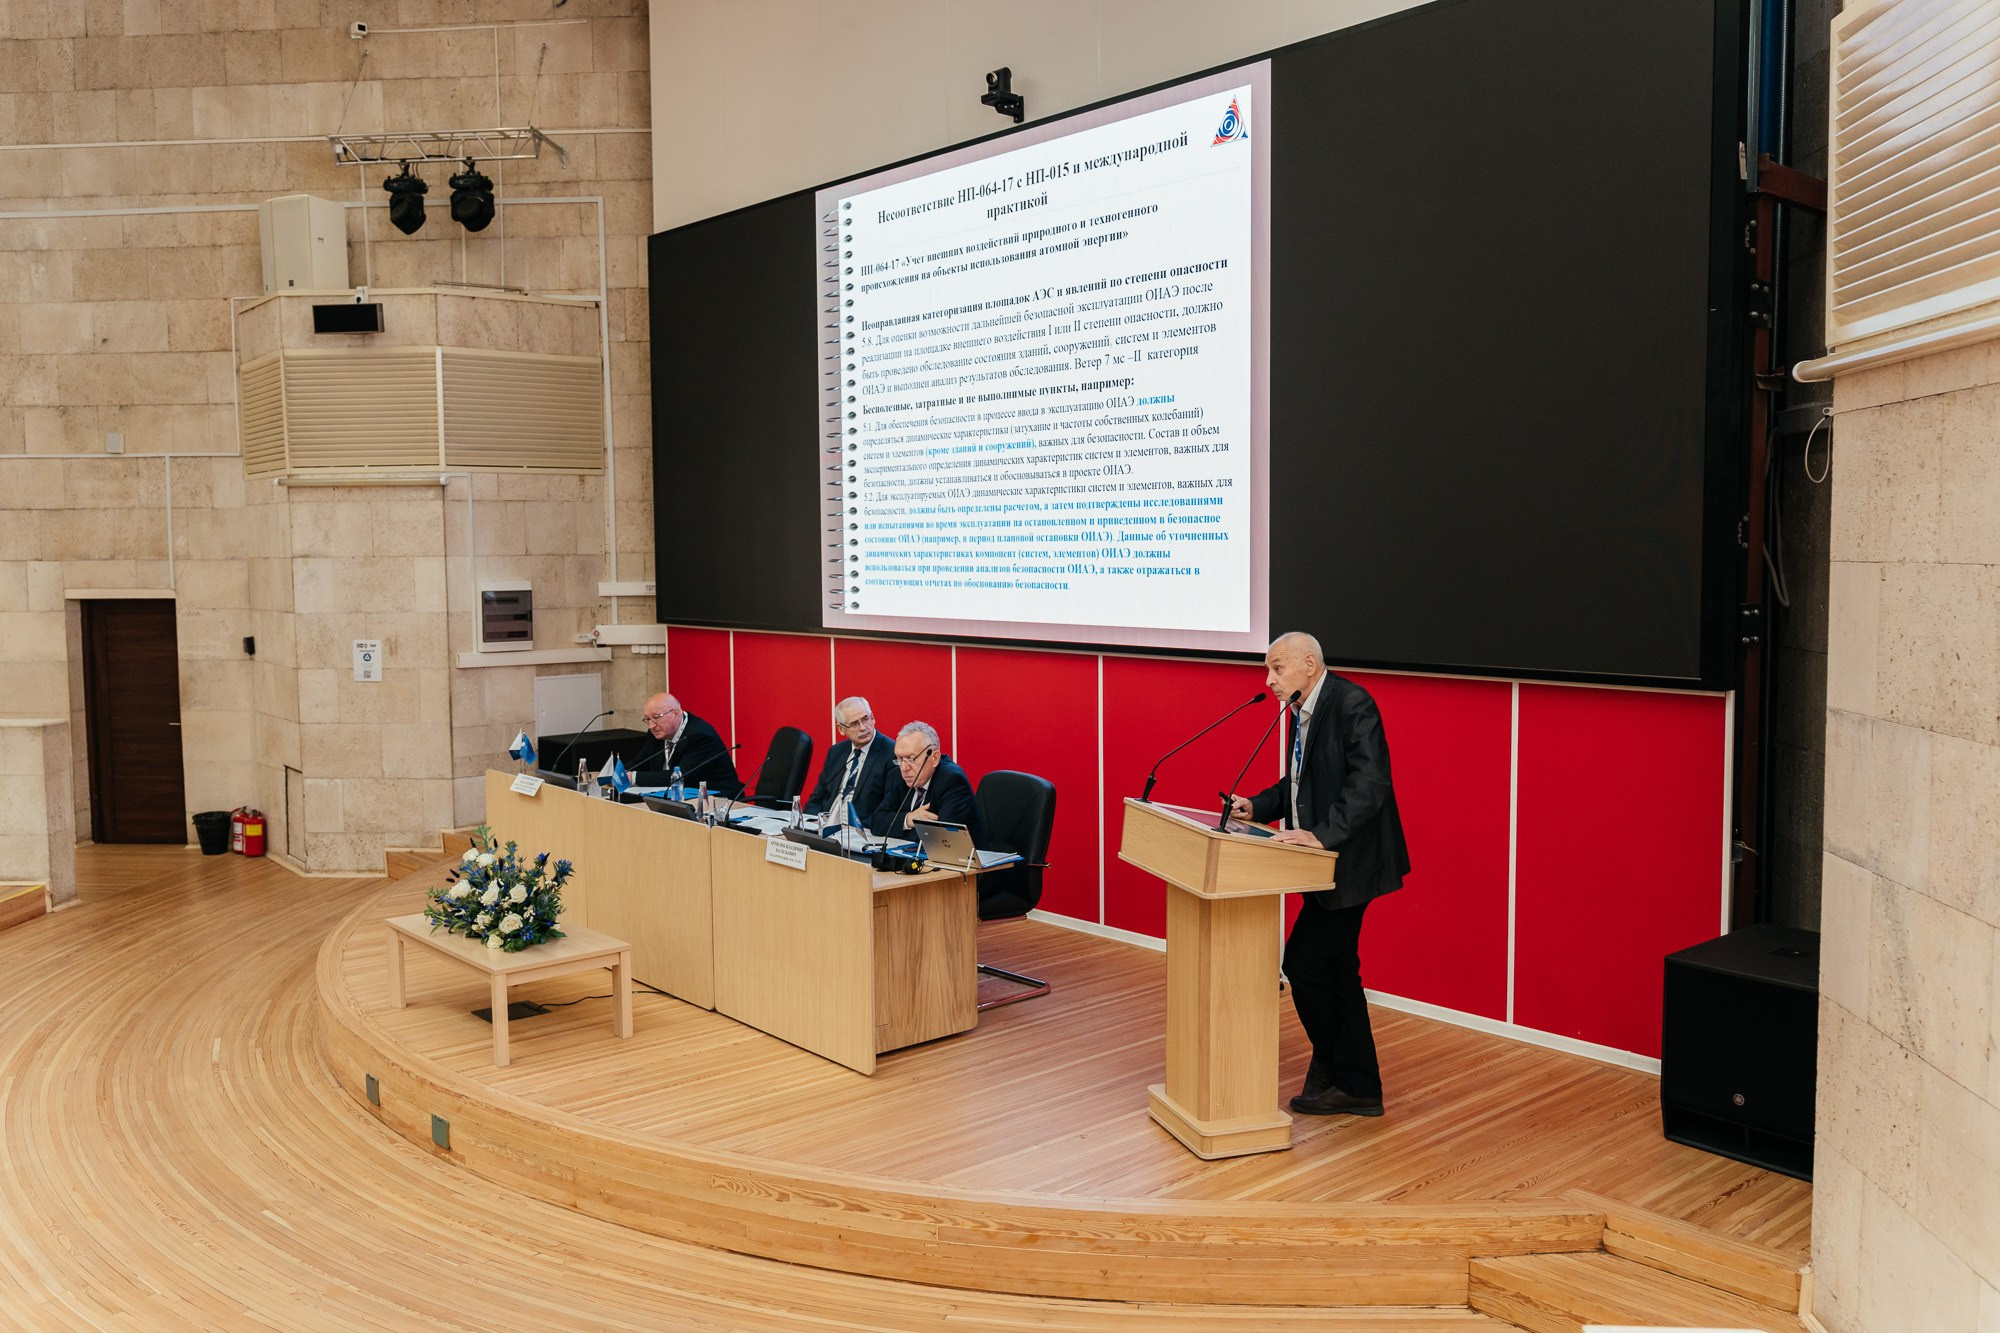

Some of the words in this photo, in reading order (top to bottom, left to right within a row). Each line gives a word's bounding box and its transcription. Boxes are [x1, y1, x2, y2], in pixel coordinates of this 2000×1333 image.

[878, 196, 955, 224] Несоответствие
[958, 177, 1013, 203] НП-064-17
[1017, 179, 1022, 188] с
[1026, 162, 1070, 186] НП-015
[1073, 163, 1080, 174] и
[1084, 131, 1188, 171] международной
[987, 191, 1048, 221] практикой
[927, 248, 964, 262] внешних
[965, 232, 1020, 254] воздействий
[1022, 222, 1078, 243] природного
[1080, 220, 1086, 229] и
[1089, 205, 1158, 226] техногенного
[921, 272, 931, 280] на
[932, 264, 968, 277] объекты
[970, 249, 1037, 270] использования
[1039, 237, 1080, 256] атомной
[1082, 231, 1129, 247] энергии»
[922, 303, 983, 320] категоризация
[985, 295, 1030, 310] площадок
[1032, 287, 1054, 301] АЭС
[1057, 289, 1063, 297] и
[1065, 278, 1107, 295] явлений
[1110, 278, 1123, 288] по
[1124, 270, 1167, 285] степени
[1169, 259, 1228, 277] опасности
[971, 311, 1022, 330] дальнейшей
[1023, 303, 1075, 321] безопасной
[1077, 294, 1143, 312] эксплуатации
[1182, 283, 1213, 296] после
[994, 329, 1046, 344] воздействия
[1054, 325, 1071, 335] или
[1083, 317, 1122, 330] степени
[1123, 308, 1179, 324] опасности,
[1181, 302, 1223, 317] должно
[974, 352, 1016, 365] состояния
[1115, 333, 1150, 345] систем
[1152, 331, 1159, 340] и
[1161, 324, 1217, 339] элементов
[959, 370, 1008, 387] результатов
[1009, 362, 1072, 378] обследования.
[1074, 358, 1102, 370] Ветер
[1104, 354, 1110, 365] 7
[1112, 356, 1125, 365] мс
[1147, 346, 1199, 360] категория
[915, 398, 957, 411] затратные
[966, 396, 976, 404] не
[978, 389, 1037, 402] выполнимые
[1039, 384, 1079, 395] пункты,
[1081, 378, 1134, 392] например:
[1047, 402, 1104, 414] эксплуатацию
[1136, 395, 1175, 406] должны
[1060, 419, 1093, 429] частоты
[1094, 414, 1150, 426] собственных
[1151, 407, 1204, 422] колебаний)
[1070, 437, 1085, 446] для
[1086, 432, 1146, 444] безопасности.
[1148, 428, 1180, 439] Состав
[1182, 428, 1189, 437] и
[1190, 424, 1220, 436] объем
[1084, 451, 1114, 460] систем
[1115, 450, 1121, 458] и
[1123, 447, 1172, 457] элементов,
[1173, 444, 1210, 454] важных
[1211, 443, 1229, 453] для
[1068, 469, 1102, 480] проекте
[1087, 484, 1117, 492] систем
[1119, 483, 1125, 491] и
[1126, 481, 1175, 491] элементов,
[1177, 480, 1214, 489] важных
[1215, 479, 1233, 488] для
[1076, 500, 1141, 511] подтверждены
[1143, 497, 1223, 507] исследованиями
[1097, 517, 1157, 528] приведенном
[1159, 516, 1165, 524] в
[1167, 513, 1221, 524] безопасное
[1117, 531, 1153, 542] Данные
[1156, 530, 1167, 541] об
[1168, 532, 1229, 541] уточненных
[1053, 548, 1100, 560] элементов)
[1132, 550, 1171, 559] должны
[1107, 567, 1134, 575] также
[1136, 567, 1192, 578] отражаться
